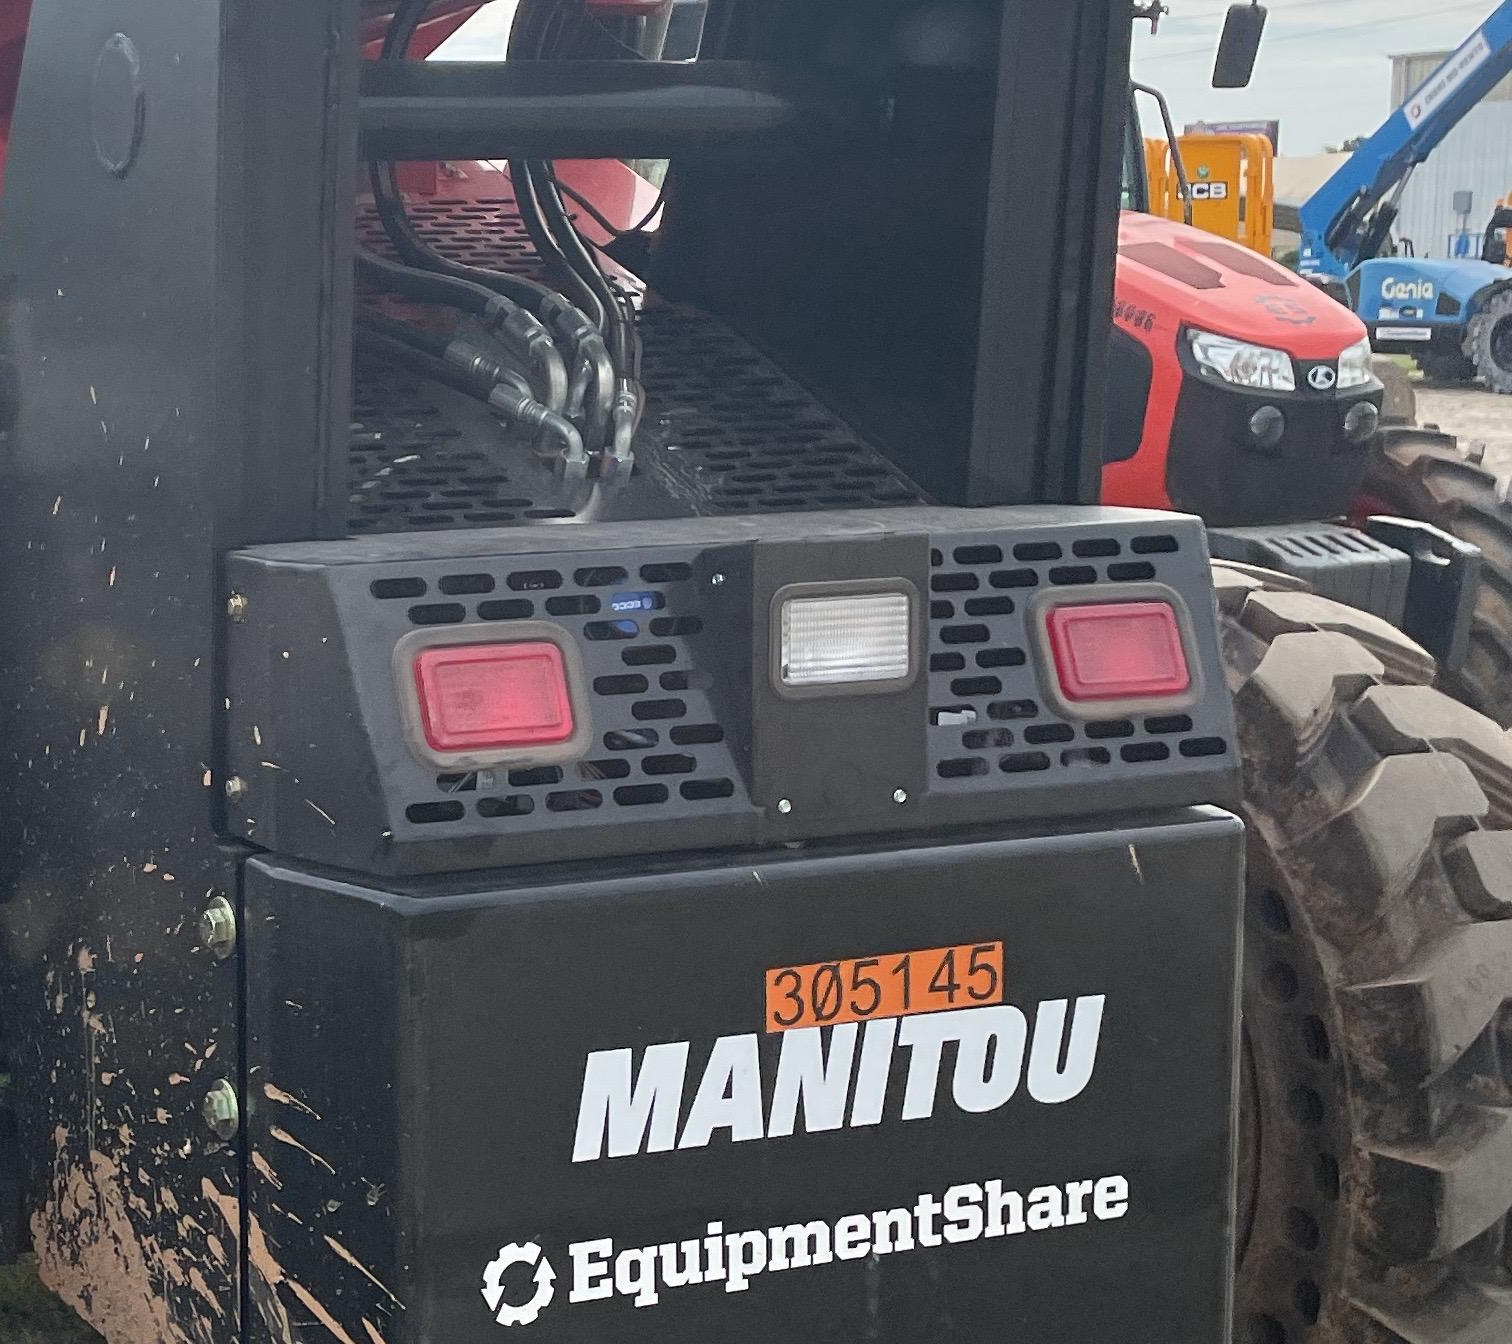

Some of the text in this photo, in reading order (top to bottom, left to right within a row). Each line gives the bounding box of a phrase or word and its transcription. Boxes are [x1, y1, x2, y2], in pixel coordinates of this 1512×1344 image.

[773, 944, 999, 1026] 305145
[572, 994, 1106, 1163] MANITOU
[569, 1174, 1129, 1307] EquipmentShare
